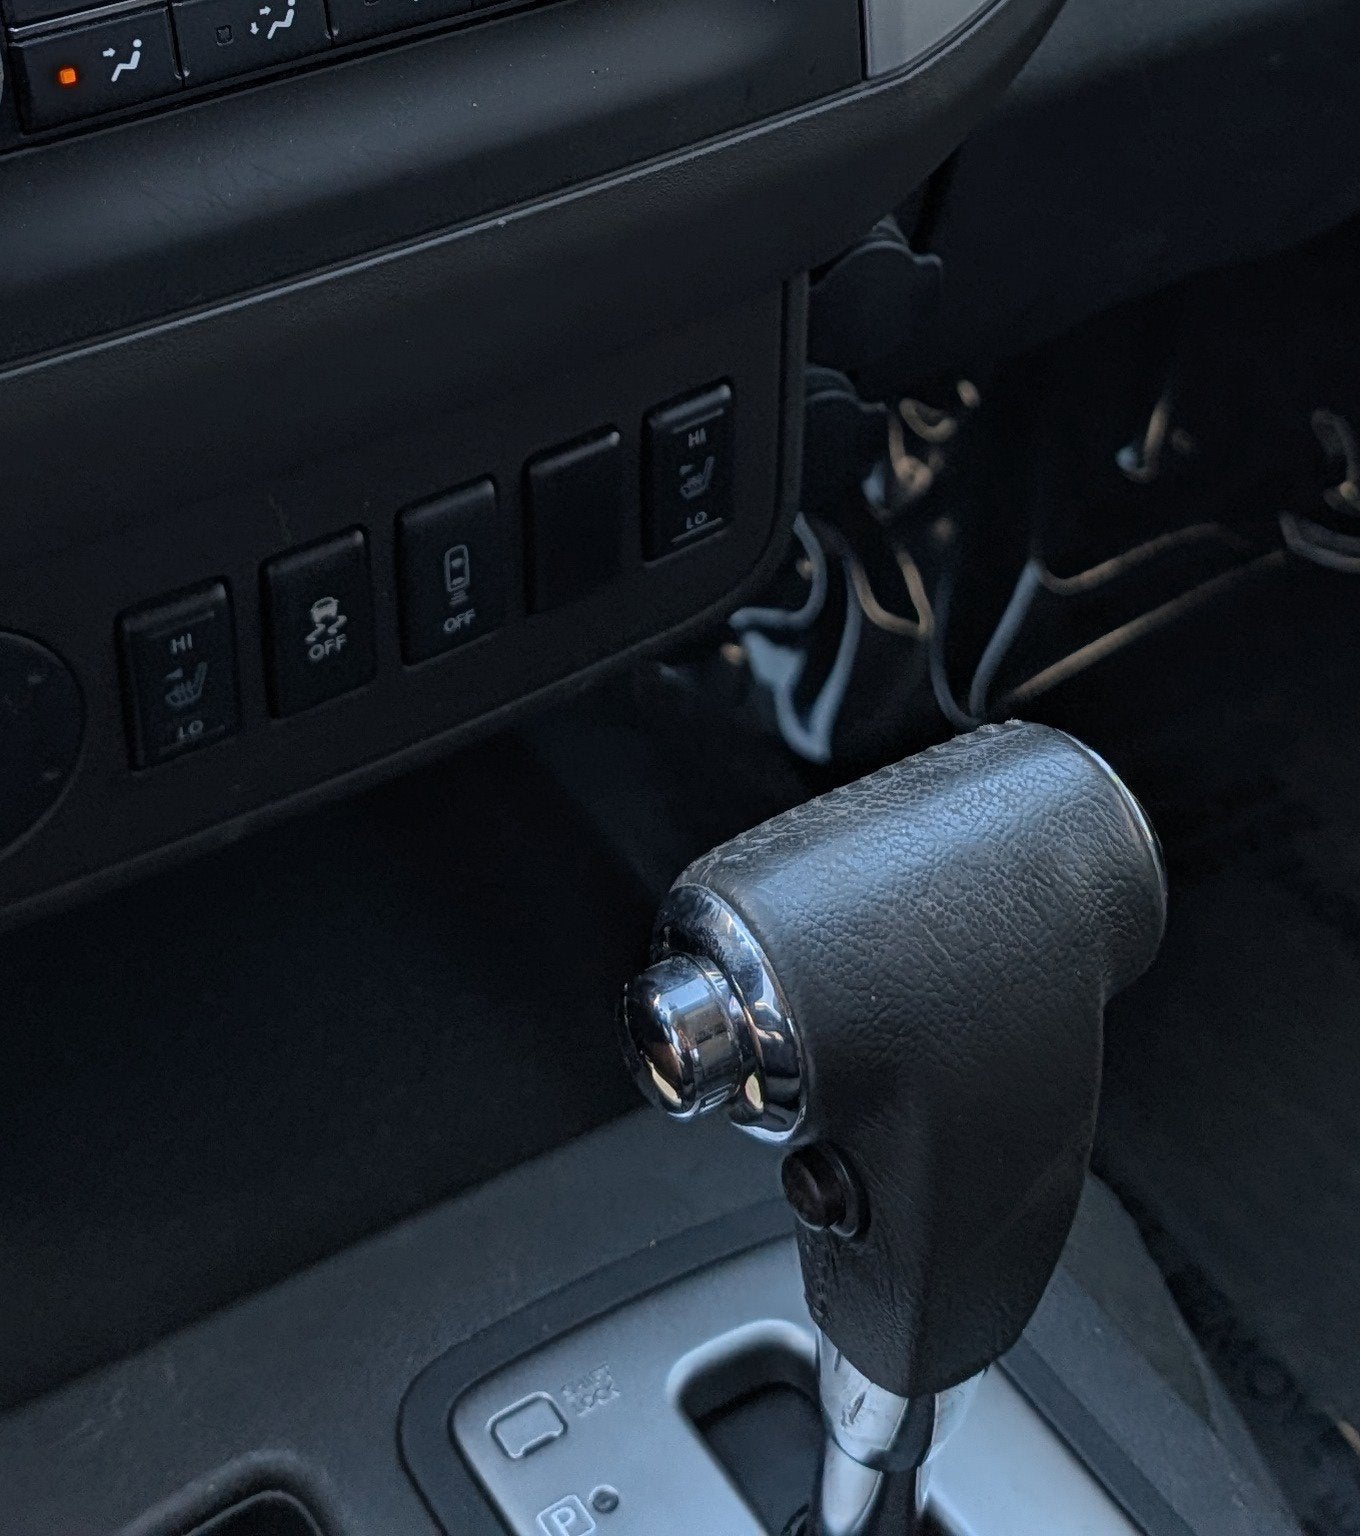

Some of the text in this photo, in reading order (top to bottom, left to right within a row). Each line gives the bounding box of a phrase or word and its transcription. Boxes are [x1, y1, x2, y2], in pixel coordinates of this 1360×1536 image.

[687, 428, 707, 449] HI
[685, 510, 708, 531] LO
[442, 608, 476, 634] OFF
[169, 632, 194, 655] HI
[307, 633, 348, 663] OFF
[176, 718, 205, 741] LO
